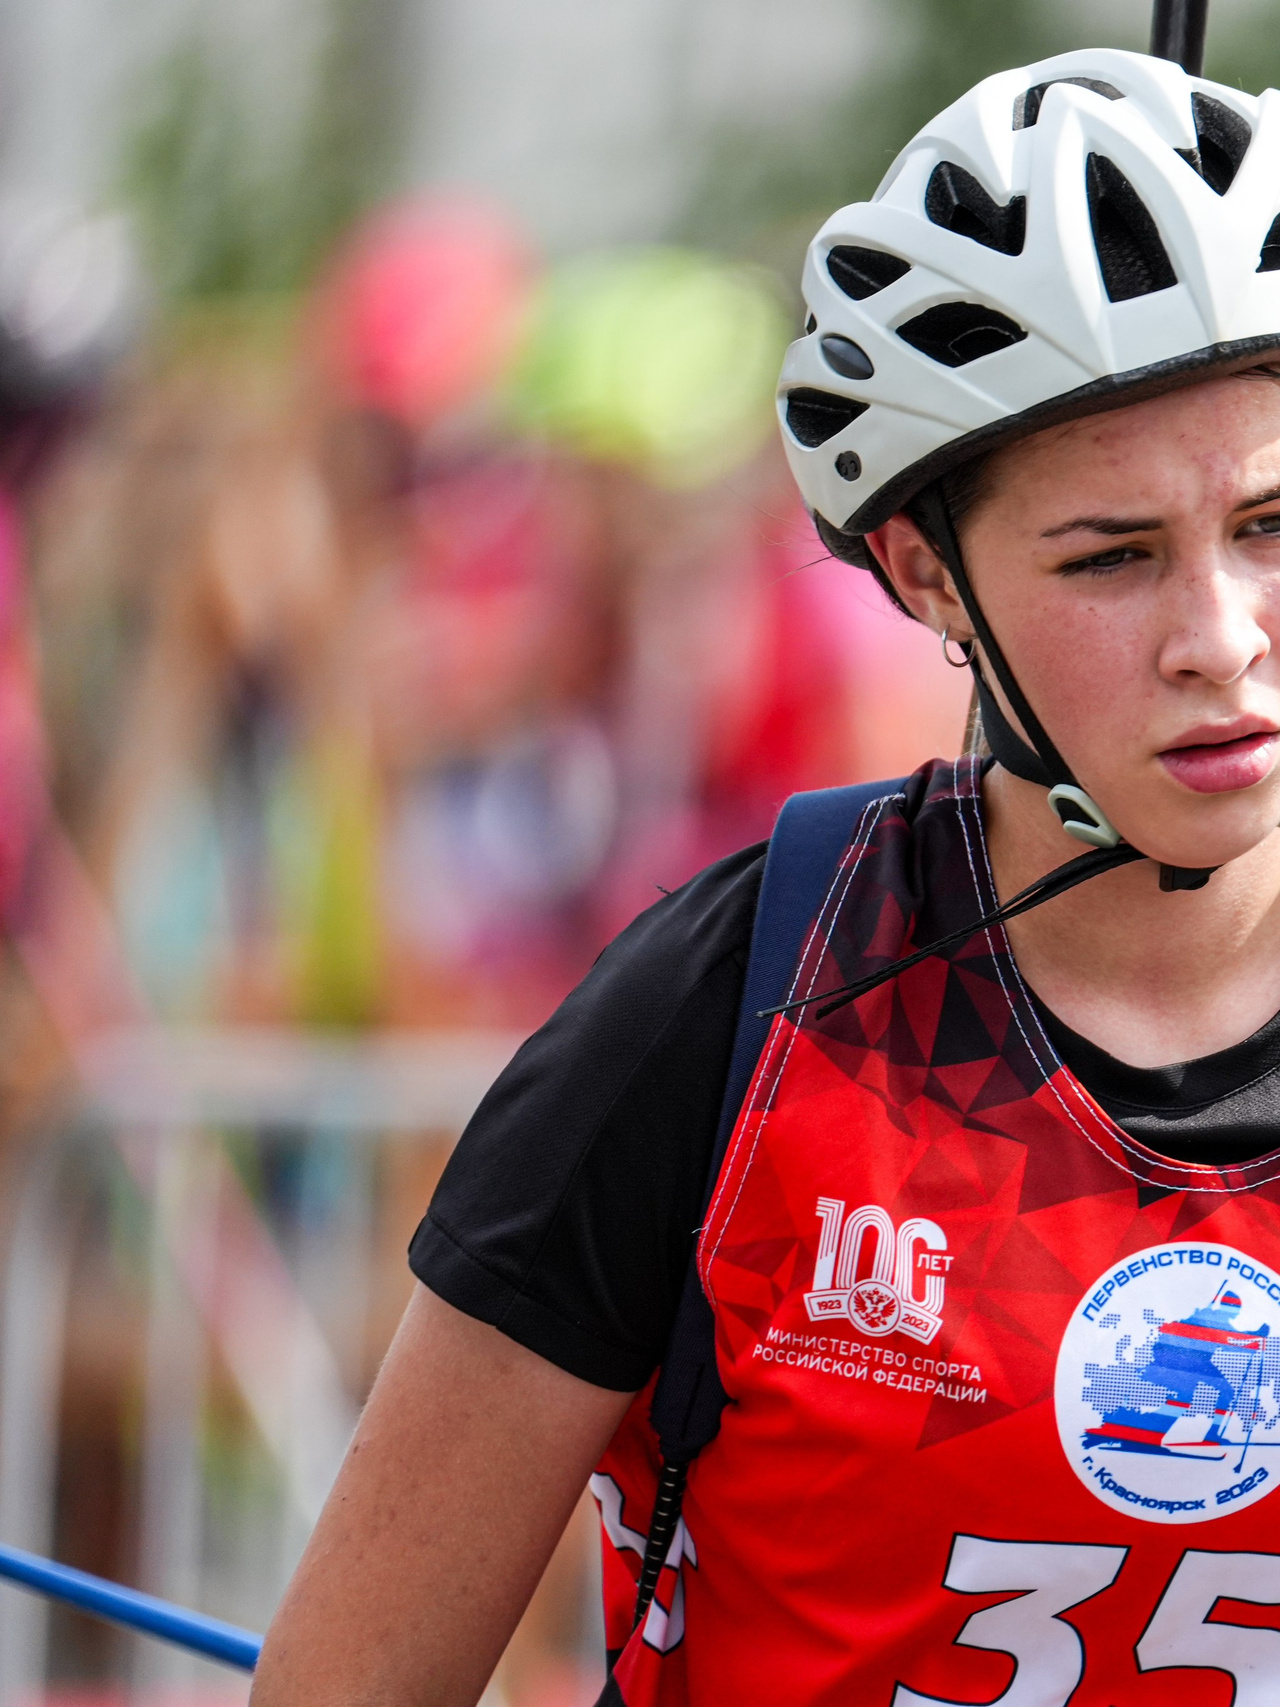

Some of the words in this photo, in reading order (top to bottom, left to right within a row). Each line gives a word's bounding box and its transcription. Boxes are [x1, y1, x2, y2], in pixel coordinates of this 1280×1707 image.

[812, 1196, 948, 1317] 100
[917, 1254, 954, 1272] ЛЕТ
[1082, 1250, 1222, 1321] ПЕРВЕНСТВО
[816, 1299, 842, 1312] 1923
[902, 1313, 929, 1332] 2023
[752, 1344, 868, 1381] РОССИЙСКОЙ
[872, 1368, 987, 1404] ФЕДЕРАЦИИ
[766, 1327, 907, 1367] МИНИСТЕРСТВО
[912, 1356, 982, 1382] СПОРТА
[1082, 1455, 1093, 1471] г.
[1093, 1467, 1206, 1514] Красноярск
[1215, 1466, 1270, 1505] 2023
